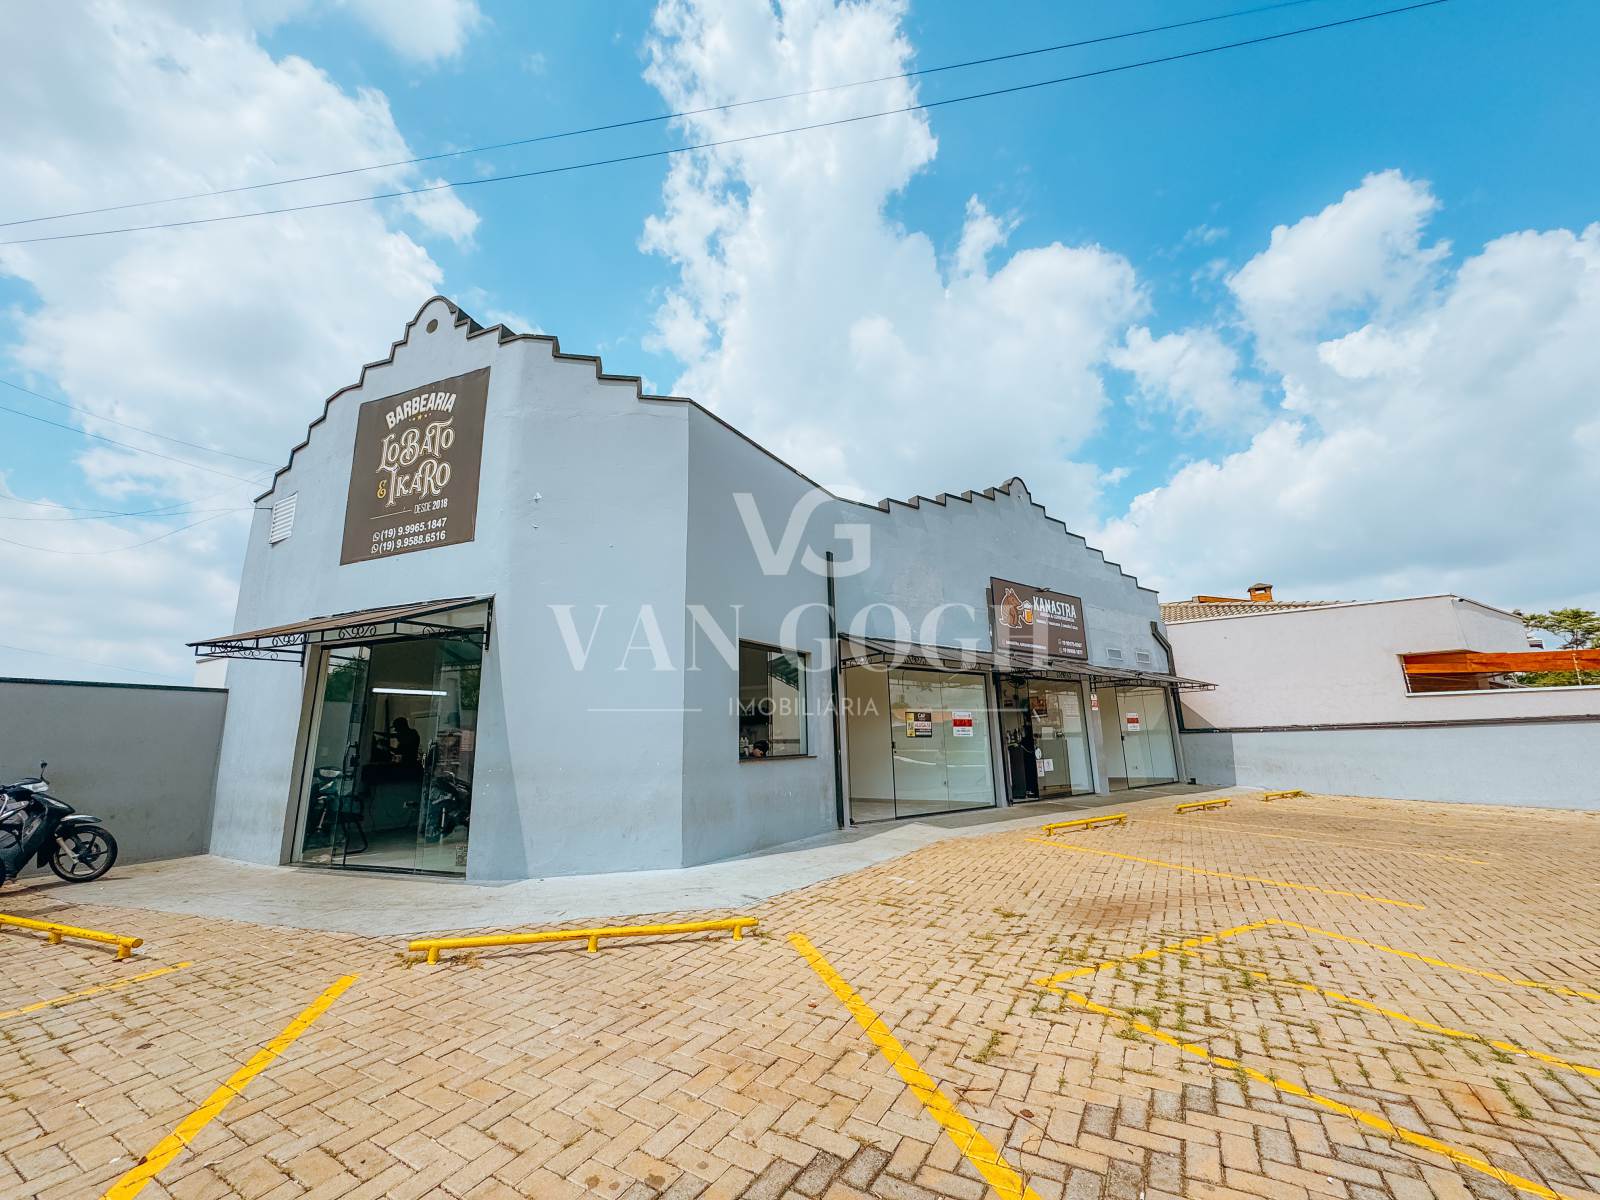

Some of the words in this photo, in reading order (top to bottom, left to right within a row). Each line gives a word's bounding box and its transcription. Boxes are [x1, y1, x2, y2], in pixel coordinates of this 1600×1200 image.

[385, 391, 457, 430] BARBEARIA
[376, 416, 456, 473] LOBATO
[385, 459, 451, 507] IKARO
[414, 502, 432, 515] DESDE
[432, 498, 449, 512] 2018
[380, 527, 396, 542] (19)
[397, 517, 448, 536] 9.9965.1847
[379, 539, 395, 553] (19)
[1032, 596, 1077, 619] KANASTRA
